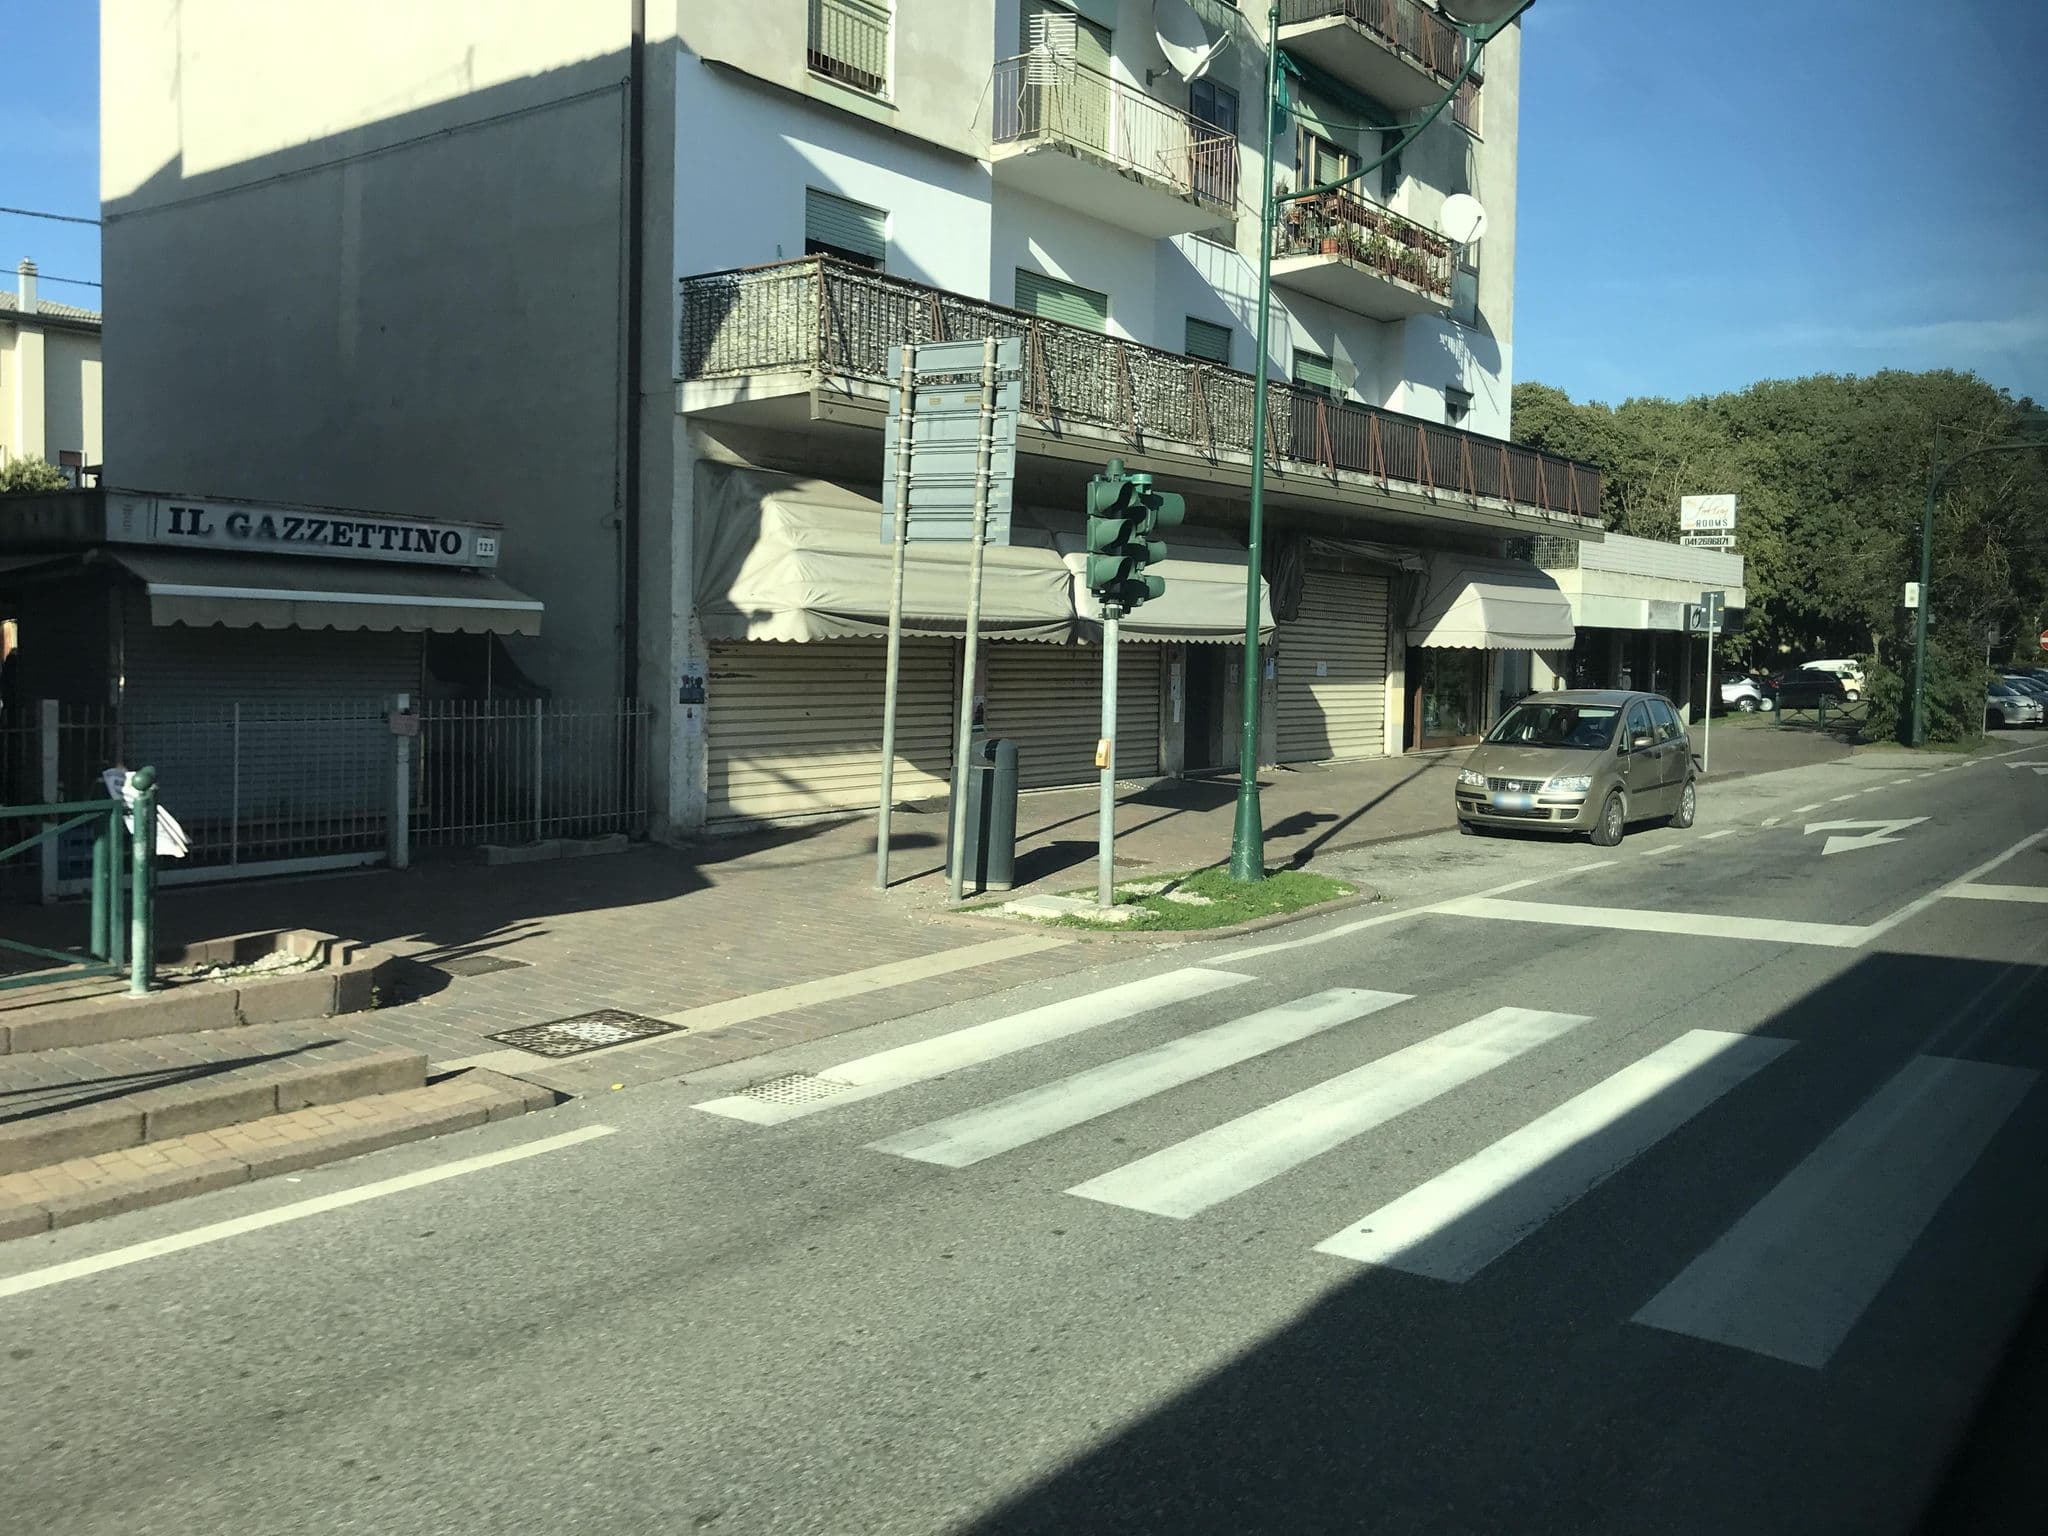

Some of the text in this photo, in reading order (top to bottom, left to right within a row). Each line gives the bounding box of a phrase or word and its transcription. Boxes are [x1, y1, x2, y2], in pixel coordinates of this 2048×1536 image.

[1696, 519, 1728, 528] ROOMS
[168, 507, 213, 536] IL
[225, 512, 462, 555] GAZZETTINO
[479, 542, 494, 552] 123
